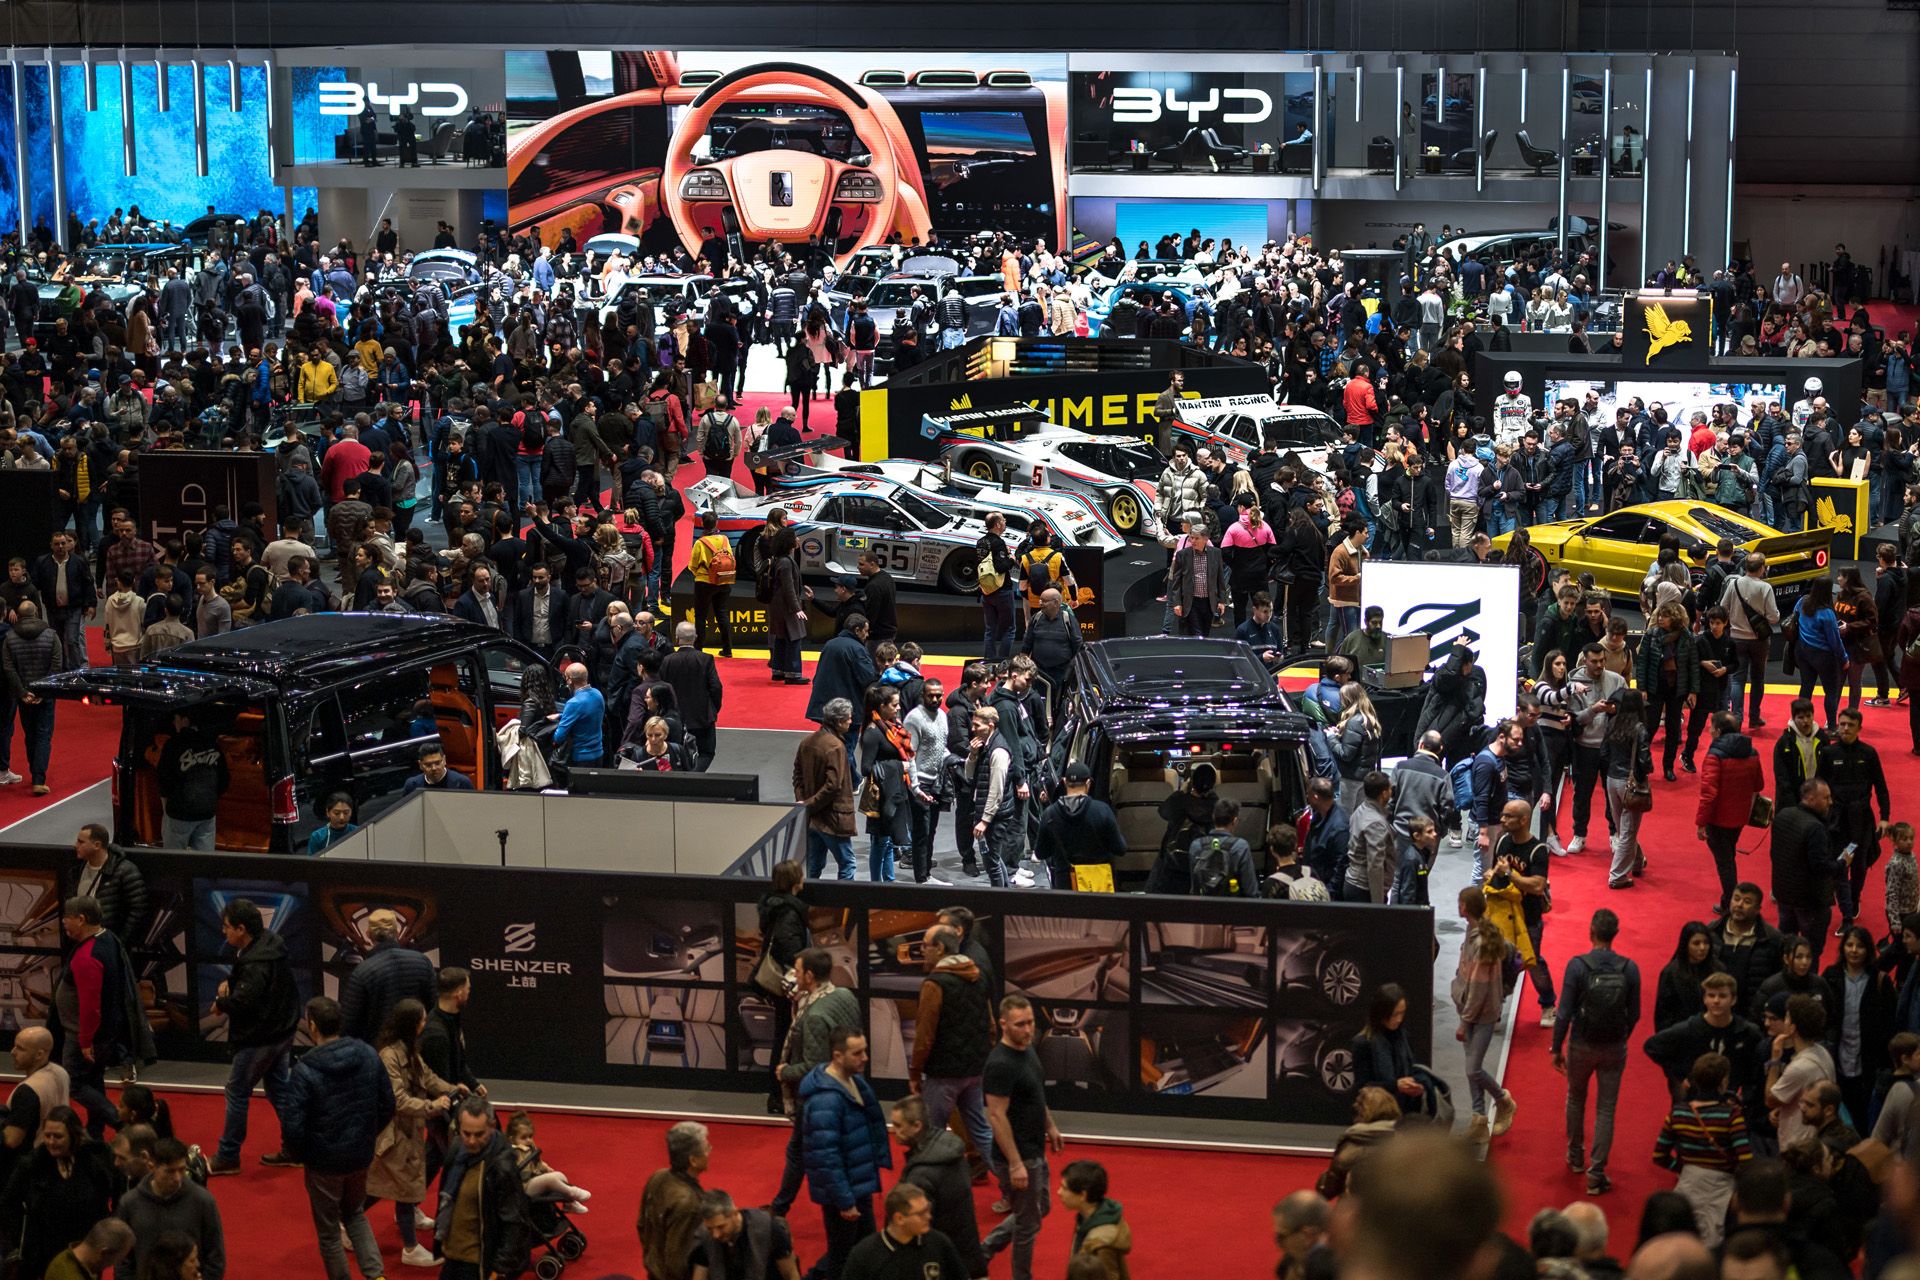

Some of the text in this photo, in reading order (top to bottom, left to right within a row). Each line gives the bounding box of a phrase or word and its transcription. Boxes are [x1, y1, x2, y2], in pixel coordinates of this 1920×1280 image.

[319, 82, 468, 116] BYD
[1113, 88, 1273, 123] BYD
[1178, 396, 1270, 410] MARTINI RACING
[1032, 465, 1044, 487] 5
[872, 543, 909, 571] 65
[471, 958, 572, 975] SHENZER
